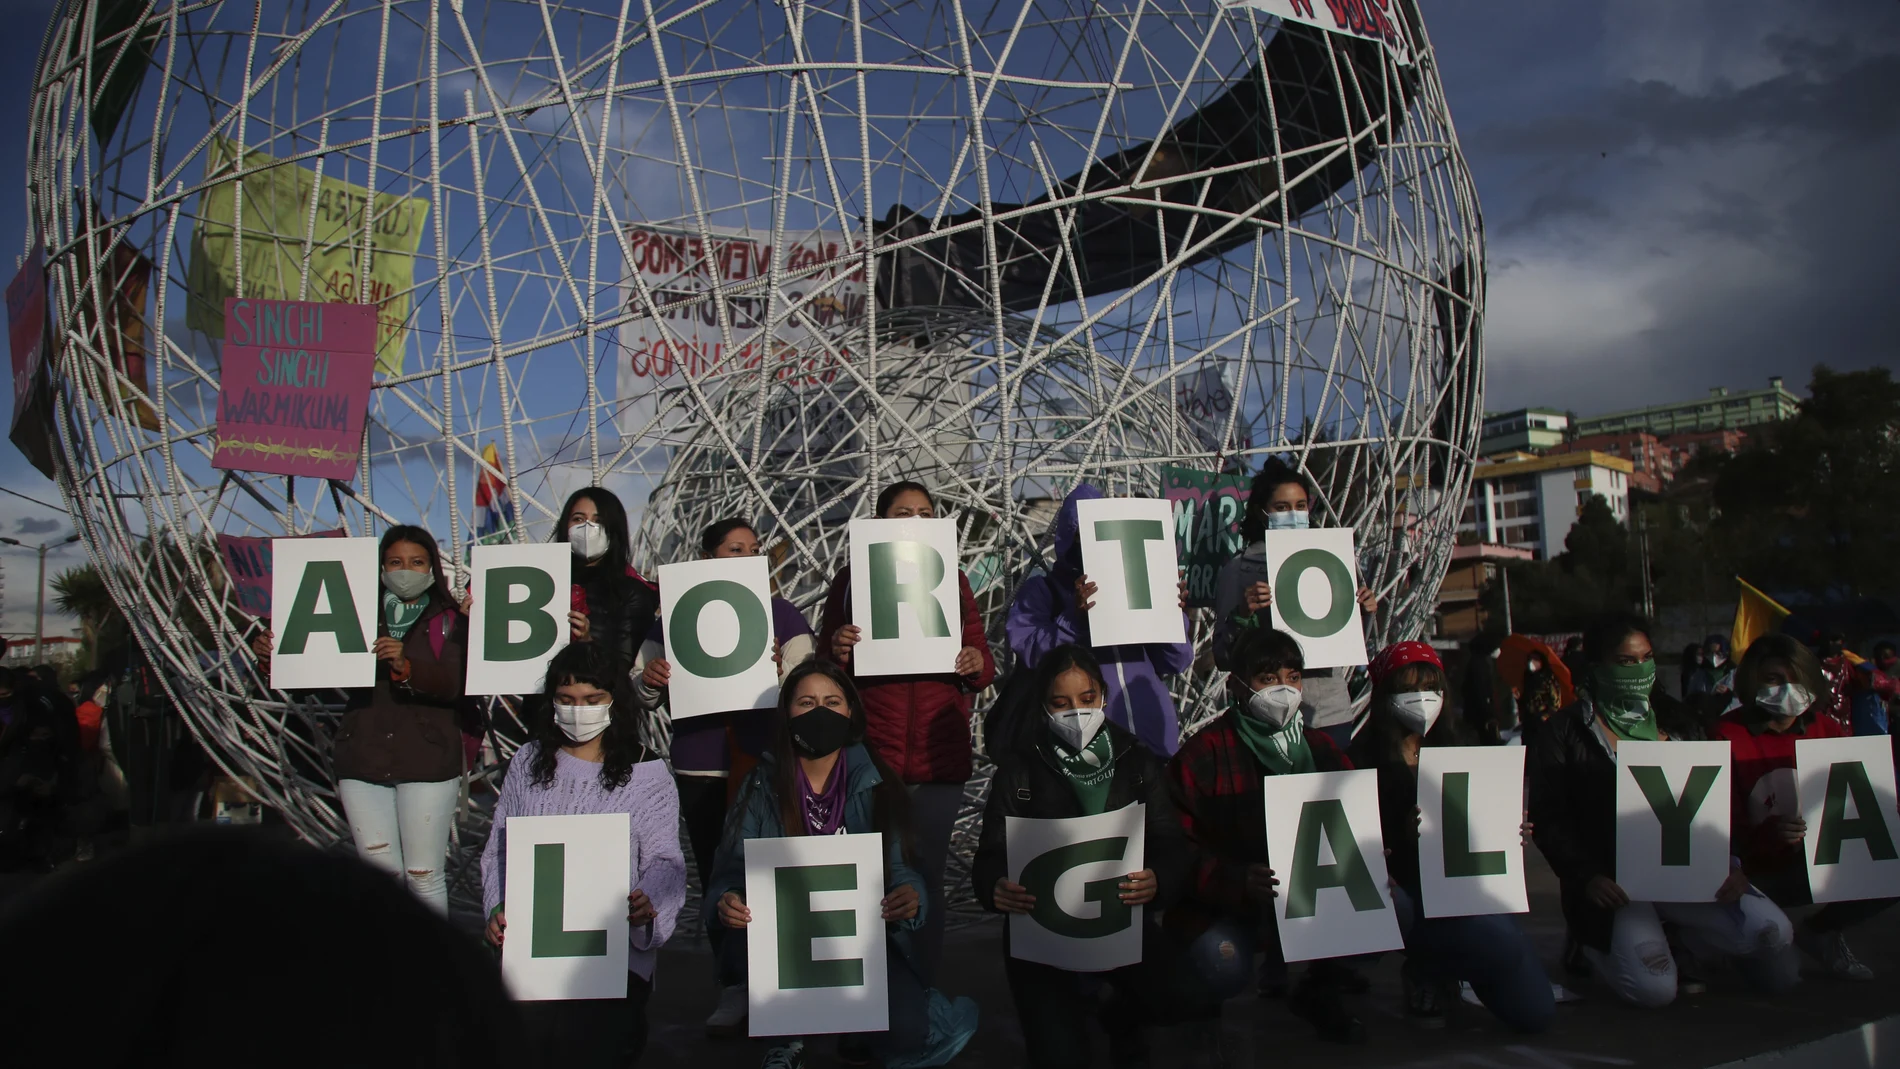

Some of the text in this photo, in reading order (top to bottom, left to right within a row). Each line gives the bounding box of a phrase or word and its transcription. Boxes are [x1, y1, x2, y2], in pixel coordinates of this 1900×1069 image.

[232, 301, 323, 346] SINCHI
[256, 348, 330, 388] SINCHI
[222, 387, 349, 434] WARMIKUNA
[1094, 519, 1165, 610] T
[1172, 496, 1244, 555] MAR
[278, 561, 368, 655] A
[484, 566, 558, 662] B
[669, 580, 769, 678] O
[868, 541, 951, 640] R
[1274, 548, 1356, 638] O
[1285, 798, 1386, 919] A
[1441, 772, 1507, 878] L
[1627, 765, 1723, 866] Y
[1814, 761, 1899, 866] A
[531, 842, 608, 958] L
[774, 863, 864, 990] E
[1018, 836, 1132, 939] G
